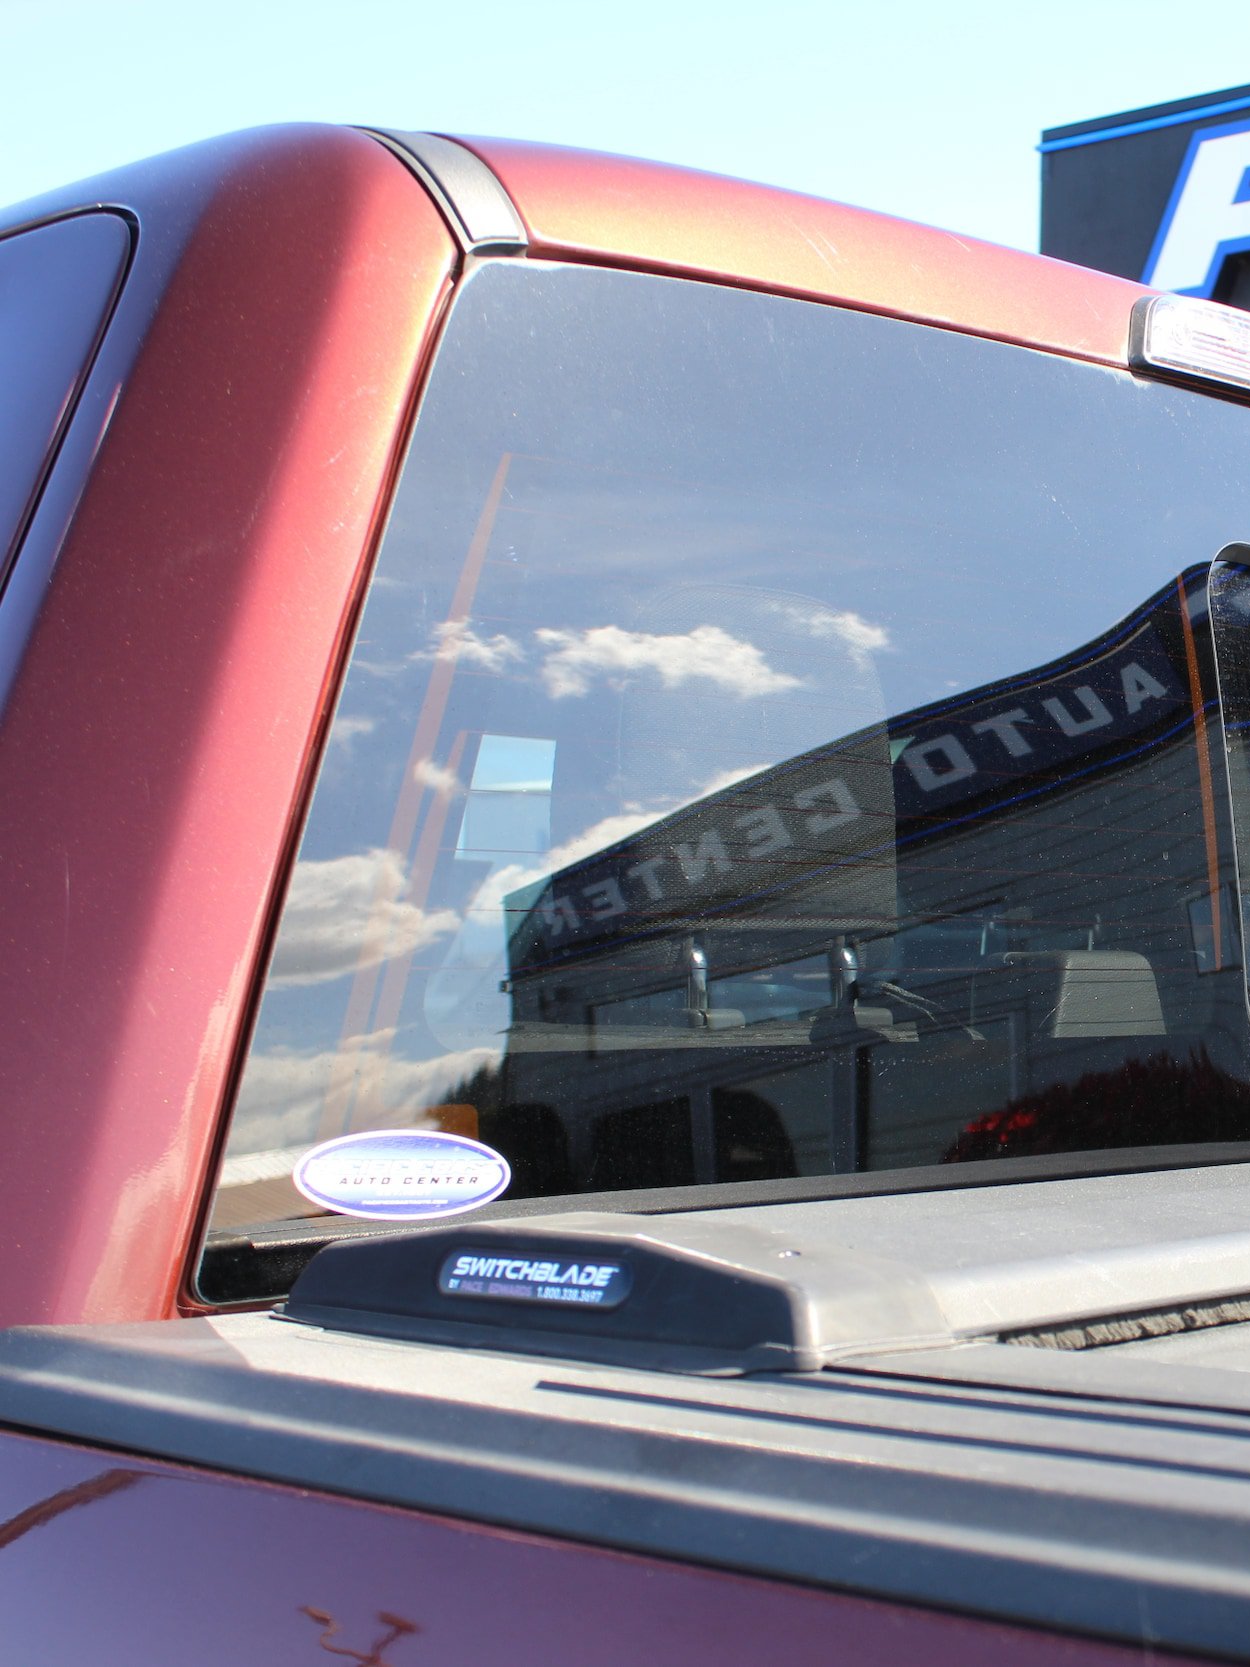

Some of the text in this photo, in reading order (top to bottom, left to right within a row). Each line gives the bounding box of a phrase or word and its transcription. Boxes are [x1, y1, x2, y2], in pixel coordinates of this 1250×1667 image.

[339, 1176, 479, 1185] AUTO CENTER
[452, 1256, 615, 1287] SWITCHBLADE
[447, 1279, 460, 1289] BY
